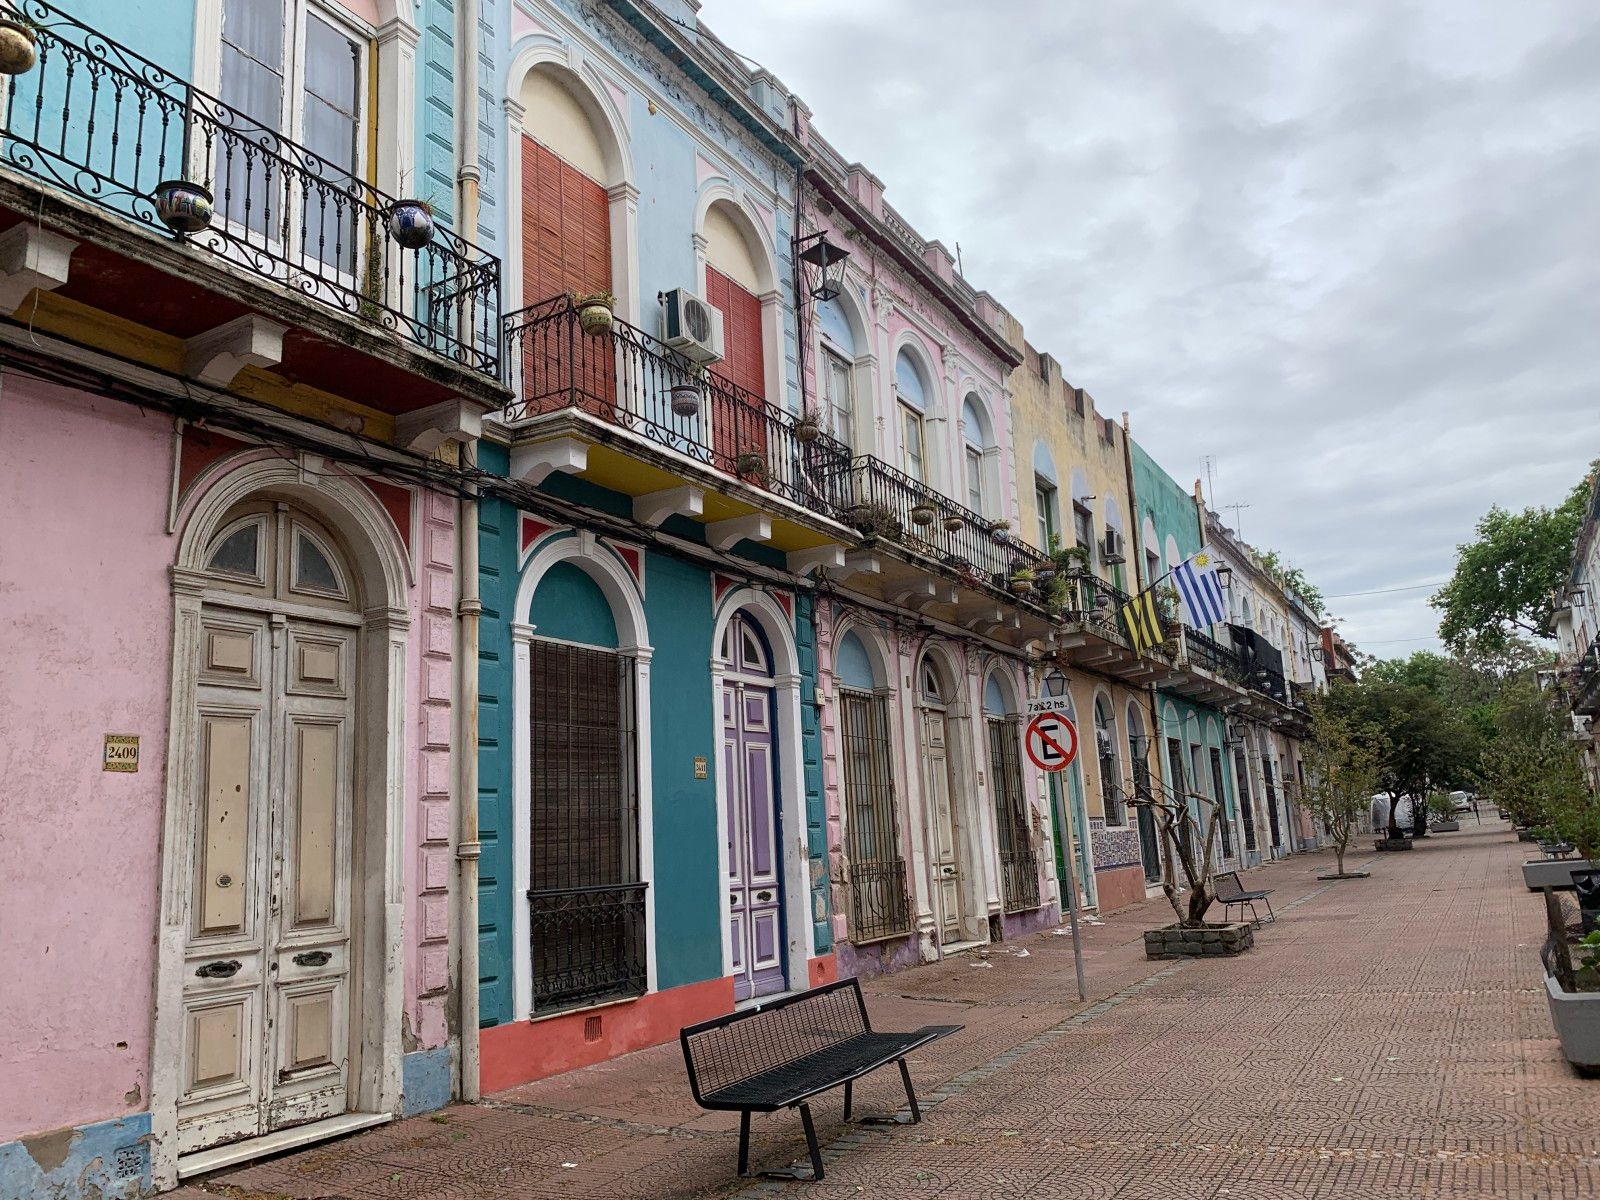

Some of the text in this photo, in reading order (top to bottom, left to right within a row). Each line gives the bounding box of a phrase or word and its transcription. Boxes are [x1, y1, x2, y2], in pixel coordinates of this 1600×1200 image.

[1027, 703, 1033, 712] 7
[1053, 700, 1068, 709] hs.
[1040, 724, 1062, 760] E
[108, 746, 137, 759] 2409
